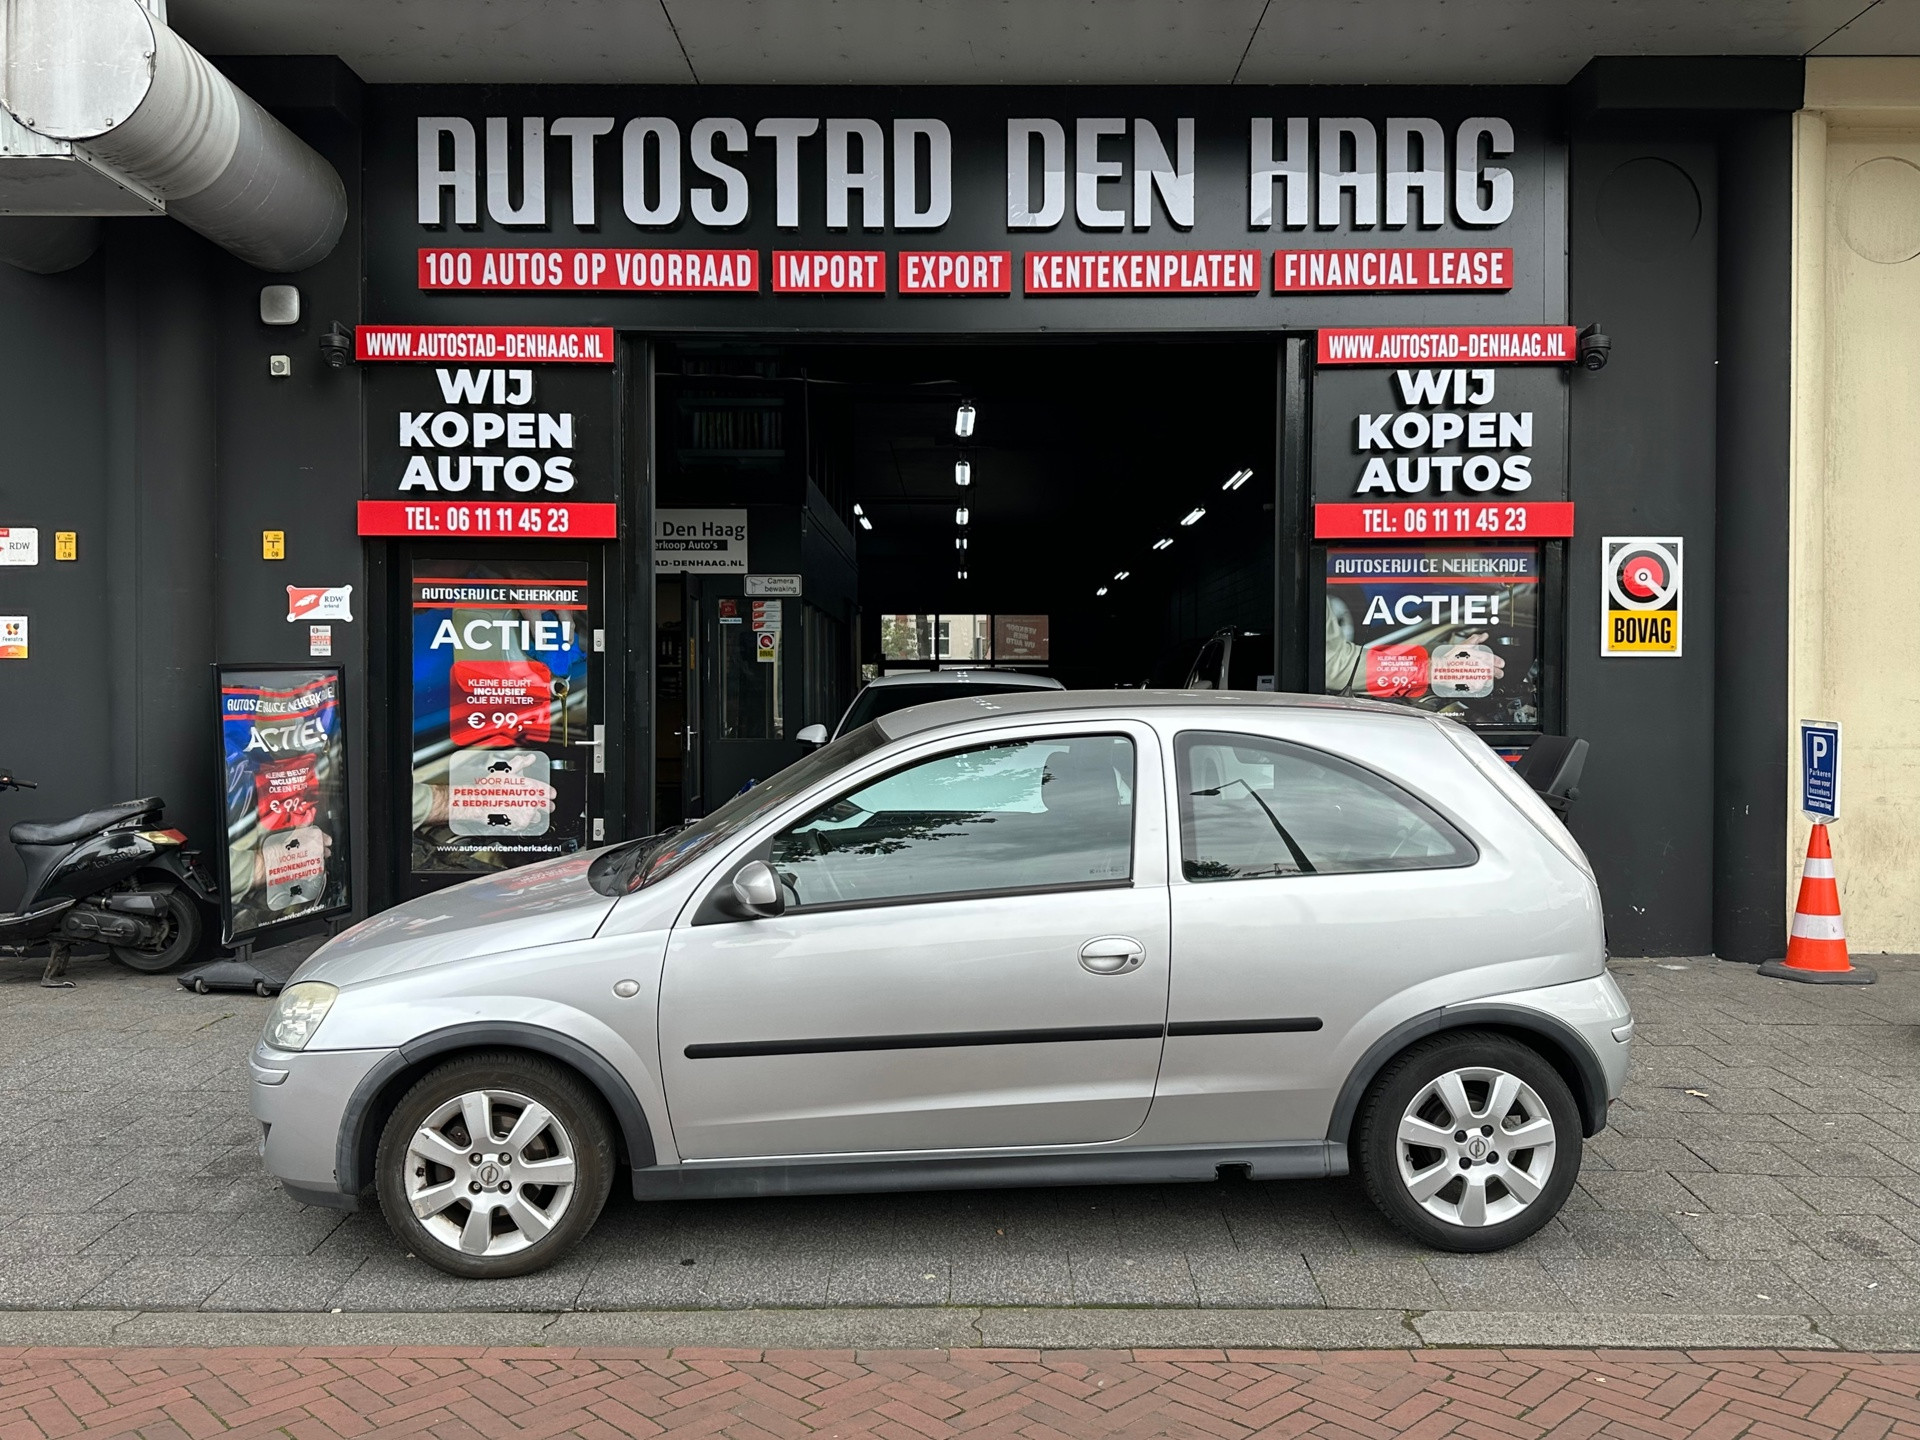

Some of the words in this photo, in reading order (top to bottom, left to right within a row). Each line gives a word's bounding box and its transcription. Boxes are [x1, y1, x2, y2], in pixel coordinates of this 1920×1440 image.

[417, 117, 952, 228] AUTOSTAD
[1007, 117, 1195, 228] DEN
[1250, 117, 1514, 228] HAAG
[426, 252, 472, 286] 100
[482, 252, 563, 286] AUTOS
[574, 253, 607, 286] OP
[615, 253, 752, 287] VOORRAAD
[779, 254, 879, 288] IMPORT
[907, 254, 1003, 289] EXPORT
[1032, 254, 1254, 289] KENTEKENPLATEN
[1284, 253, 1417, 287] FINANCIAL
[1428, 252, 1504, 285] LEASE
[366, 332, 603, 358] WWW.AUTOSTAD-DENHAAG.NL
[1328, 333, 1566, 359] WWW.AUTOSTAD-DENHAAG.NL
[436, 368, 533, 406] WIJ
[1396, 369, 1495, 405] WIJ
[399, 411, 573, 449] KOPEN
[1358, 412, 1533, 449] KOPEN
[398, 455, 575, 492] AUTOS
[1356, 455, 1532, 493] AUTOS
[405, 507, 440, 531] TEL:
[447, 507, 470, 531] 06
[475, 508, 491, 532] 11
[497, 508, 513, 532] 11
[518, 508, 542, 532] 45
[548, 509, 569, 533] 23
[663, 521, 697, 537] Den
[702, 521, 745, 541] Haag
[1363, 508, 1397, 533] TEL:
[1404, 508, 1426, 532] 06
[1433, 508, 1448, 532] 11
[1454, 508, 1470, 532] 11
[1476, 508, 1499, 531] 45
[1505, 508, 1526, 531] 23
[9, 542, 30, 550] RDW
[688, 541, 718, 550] Auto's
[1335, 558, 1438, 573] AUTOSERVICE
[1442, 558, 1528, 573] NEHERKADE
[422, 588, 507, 601] AUTOSERVICE
[510, 588, 579, 602] NEHERKADE
[764, 586, 797, 594] bewaking
[1362, 594, 1500, 626] ACTIE!
[430, 619, 572, 652] ACTIE!
[1614, 617, 1671, 644] BOVAG
[468, 679, 501, 687] KLEINE
[502, 679, 532, 687] BEURT
[473, 688, 526, 696] INCLUSIEF
[1377, 676, 1388, 687] €
[466, 696, 488, 705] OLIE
[489, 696, 503, 705] EN
[504, 696, 534, 705] FILTER
[243, 716, 328, 752] ACTIE!
[467, 712, 486, 730] €
[492, 712, 532, 732] 99,-
[1813, 736, 1827, 768] P
[454, 788, 545, 797] PERSONENAUTO'S
[474, 777, 502, 786] VOOR
[503, 777, 525, 786] ALLE
[270, 800, 281, 814] €
[452, 799, 460, 808] &
[462, 799, 547, 808] BEDRIJFSAUTO'S
[437, 844, 562, 853] www.autoserviceneherkade.nl
